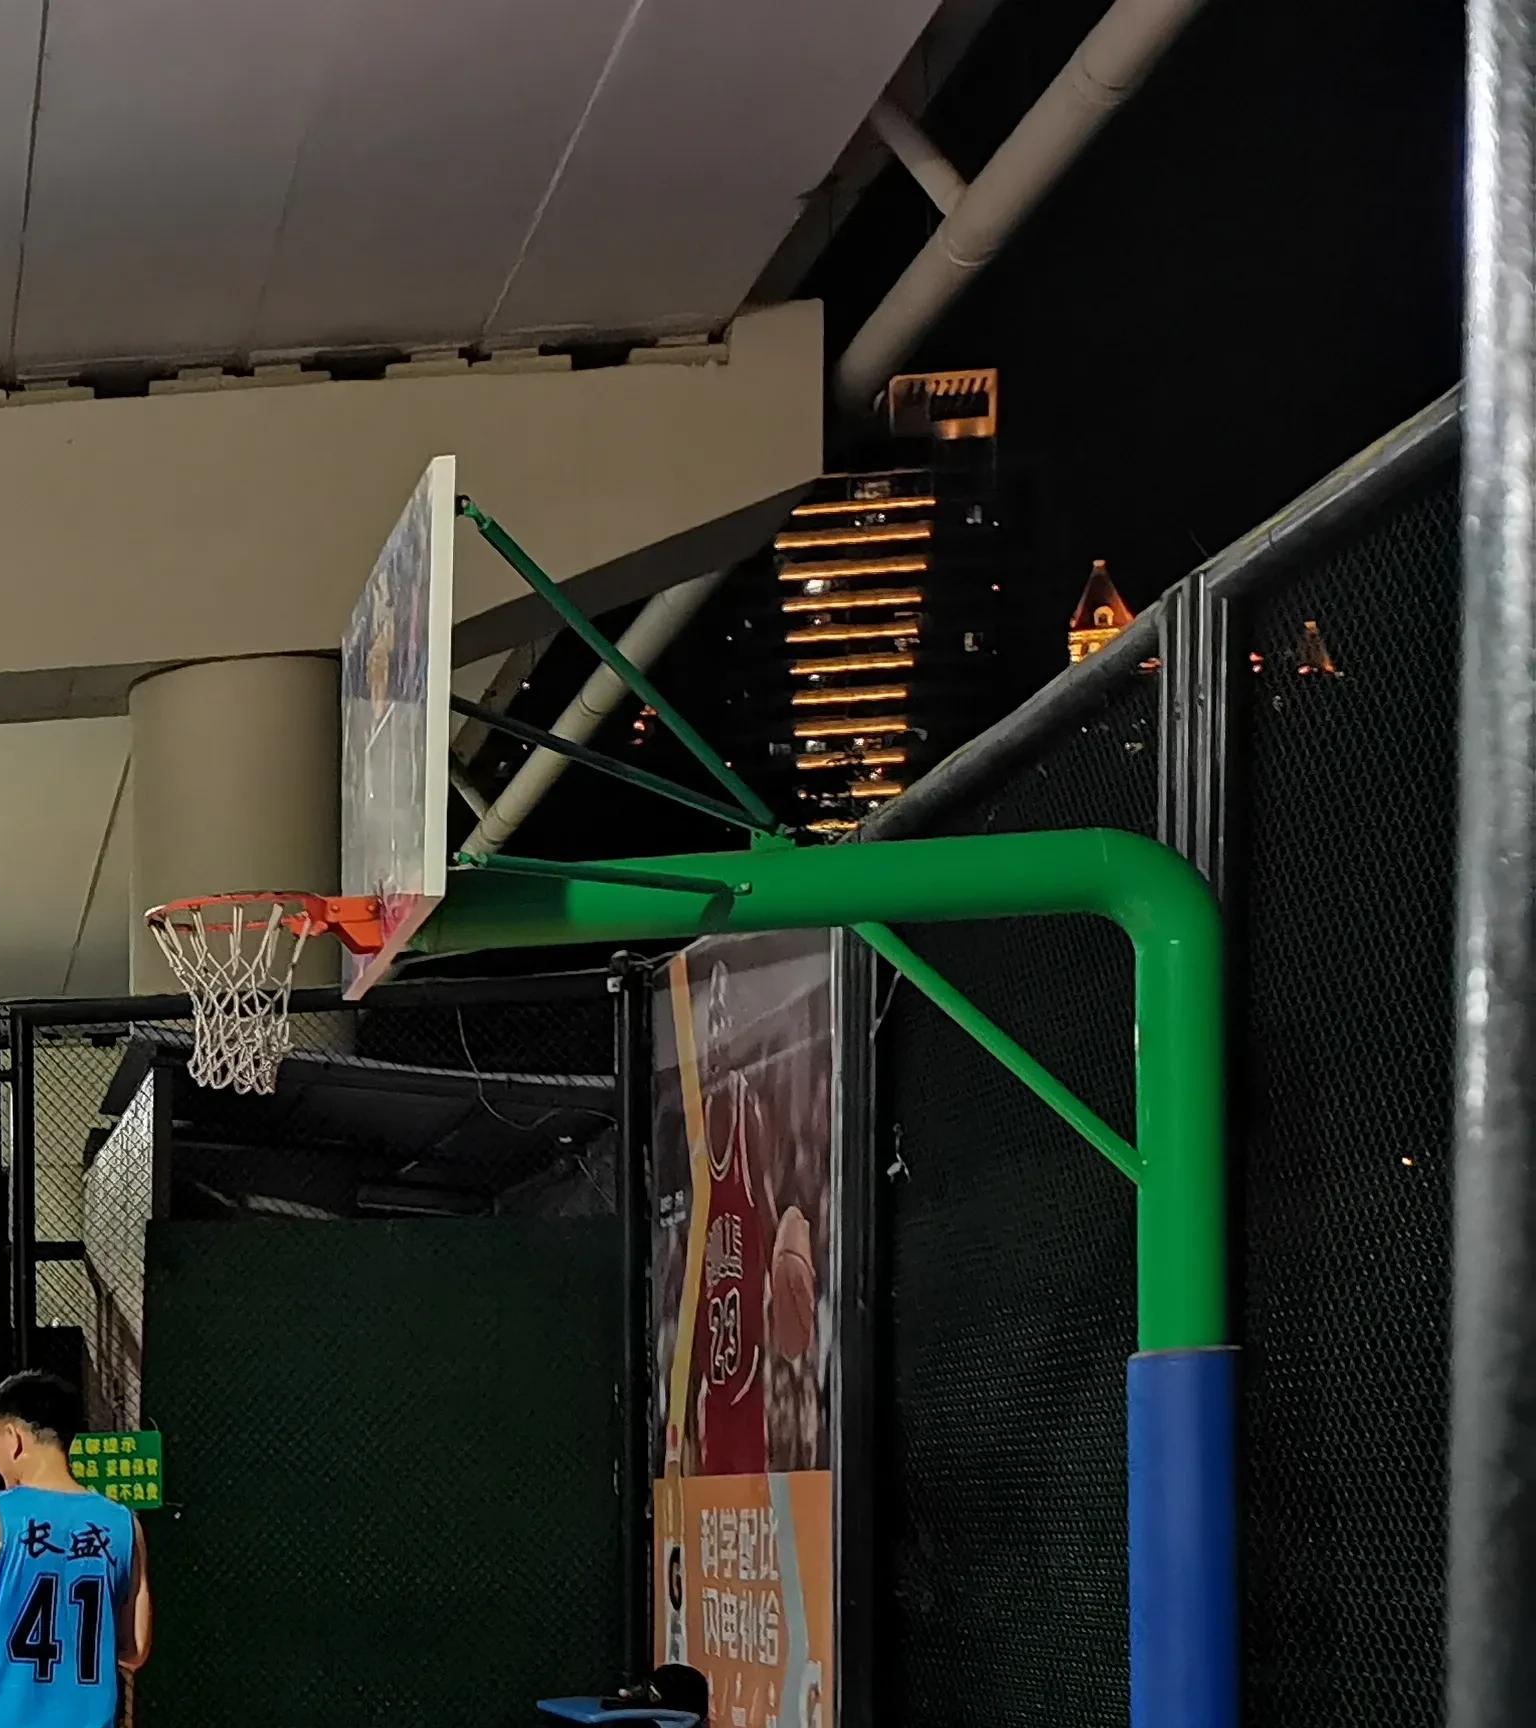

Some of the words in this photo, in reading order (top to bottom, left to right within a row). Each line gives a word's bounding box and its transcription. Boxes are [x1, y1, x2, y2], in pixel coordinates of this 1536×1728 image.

[20, 1518, 117, 1566] 长盛
[701, 1506, 778, 1581] 科学配比
[7, 1571, 108, 1686] 41
[702, 1586, 779, 1666] 闪电补给
